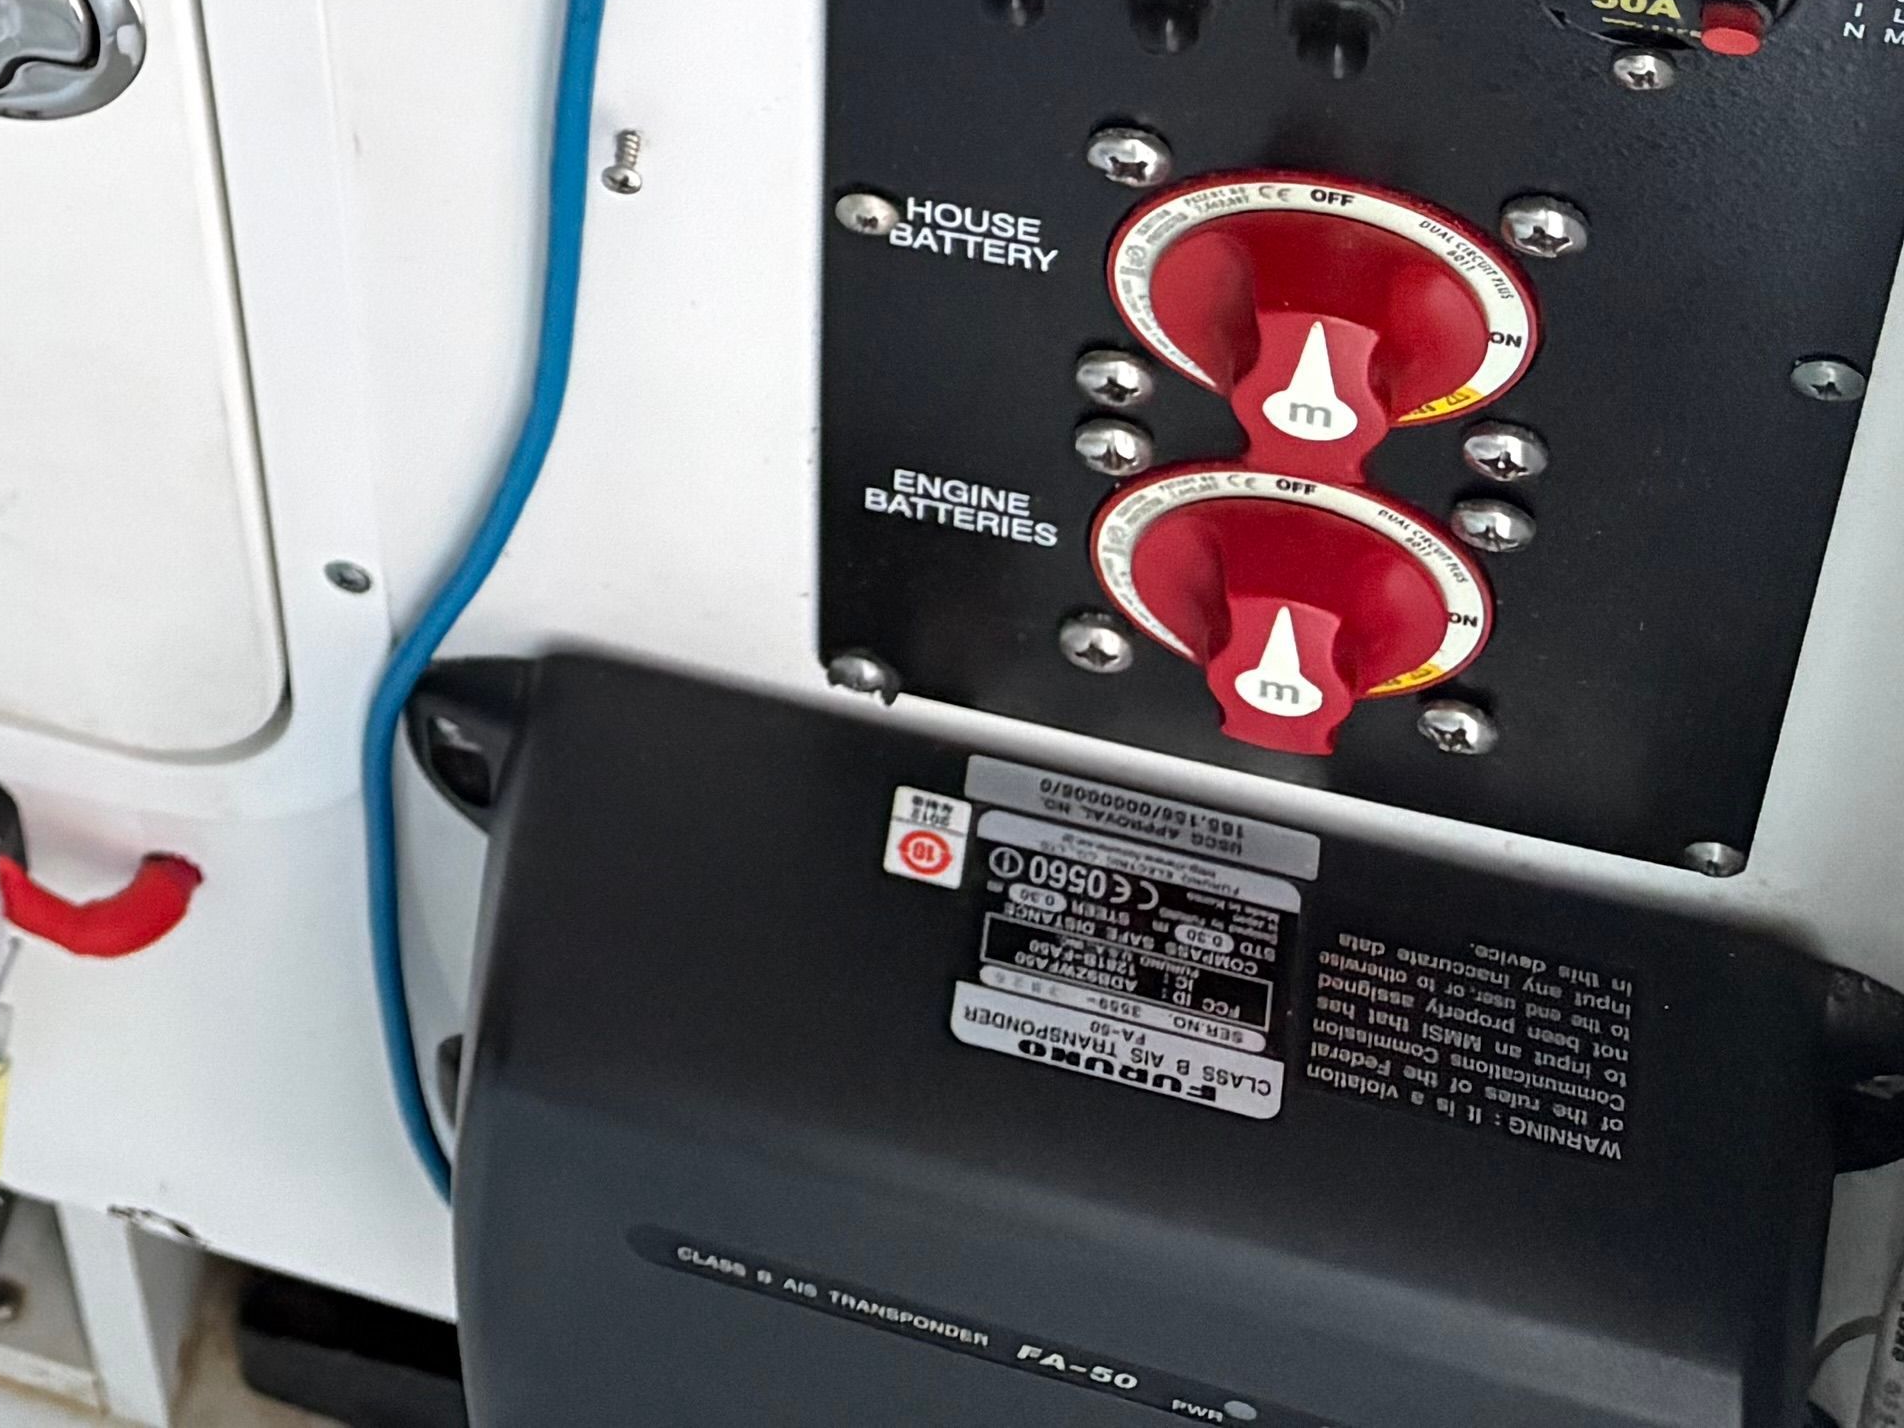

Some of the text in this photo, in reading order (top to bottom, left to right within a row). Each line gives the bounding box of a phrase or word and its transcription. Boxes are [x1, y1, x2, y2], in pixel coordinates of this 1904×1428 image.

[1310, 188, 1356, 209] OFF
[906, 196, 1042, 244] HOUSE
[889, 222, 1059, 273] BATTERY
[1418, 219, 1514, 301] DUAL CIRCUIT PLUS
[1490, 331, 1523, 349] ON
[893, 468, 1031, 517] ENGINE
[1276, 479, 1317, 497] OFF
[863, 487, 1059, 548] BATTERIES
[1377, 508, 1469, 585] DUAL CIRCUIT PLUS
[1448, 611, 1479, 627] ON
[1079, 806, 1181, 840] APPROVAL
[1191, 832, 1243, 856] USCG
[1003, 901, 1258, 976] COMPASS SAFE DISTANCE
[1318, 950, 1408, 983] otherwise
[1338, 932, 1631, 1020] input any inaccurate data
[1416, 975, 1435, 992] to
[1470, 943, 1632, 997] in this device.
[1201, 997, 1241, 1020] FCC
[1443, 982, 1465, 997] or
[1317, 972, 1628, 1062] not been properly assigned
[1525, 1002, 1562, 1021] end
[1570, 1014, 1601, 1034] the
[963, 1005, 1272, 1097] CLASS B AIS TRANSPONDER
[1089, 1020, 1146, 1046] FA-50
[1316, 995, 1627, 1088] to input an MMSI that has
[1610, 1024, 1630, 1042] to
[1017, 1038, 1217, 1103] FURUNO
[1307, 1063, 1399, 1100] violation
[1312, 1018, 1625, 1111] Communications Commission
[1310, 1041, 1624, 1132] of the rules of the Federal
[1410, 1090, 1425, 1105] a
[1436, 1097, 1455, 1117] is
[1508, 1115, 1622, 1160] WARNING
[677, 1246, 747, 1279] CLASS
[782, 1276, 818, 1299] AIS
[828, 1288, 989, 1350] TRANSPONDER
[1016, 1343, 1140, 1392] FA-50
[1171, 1397, 1226, 1424] PWR
